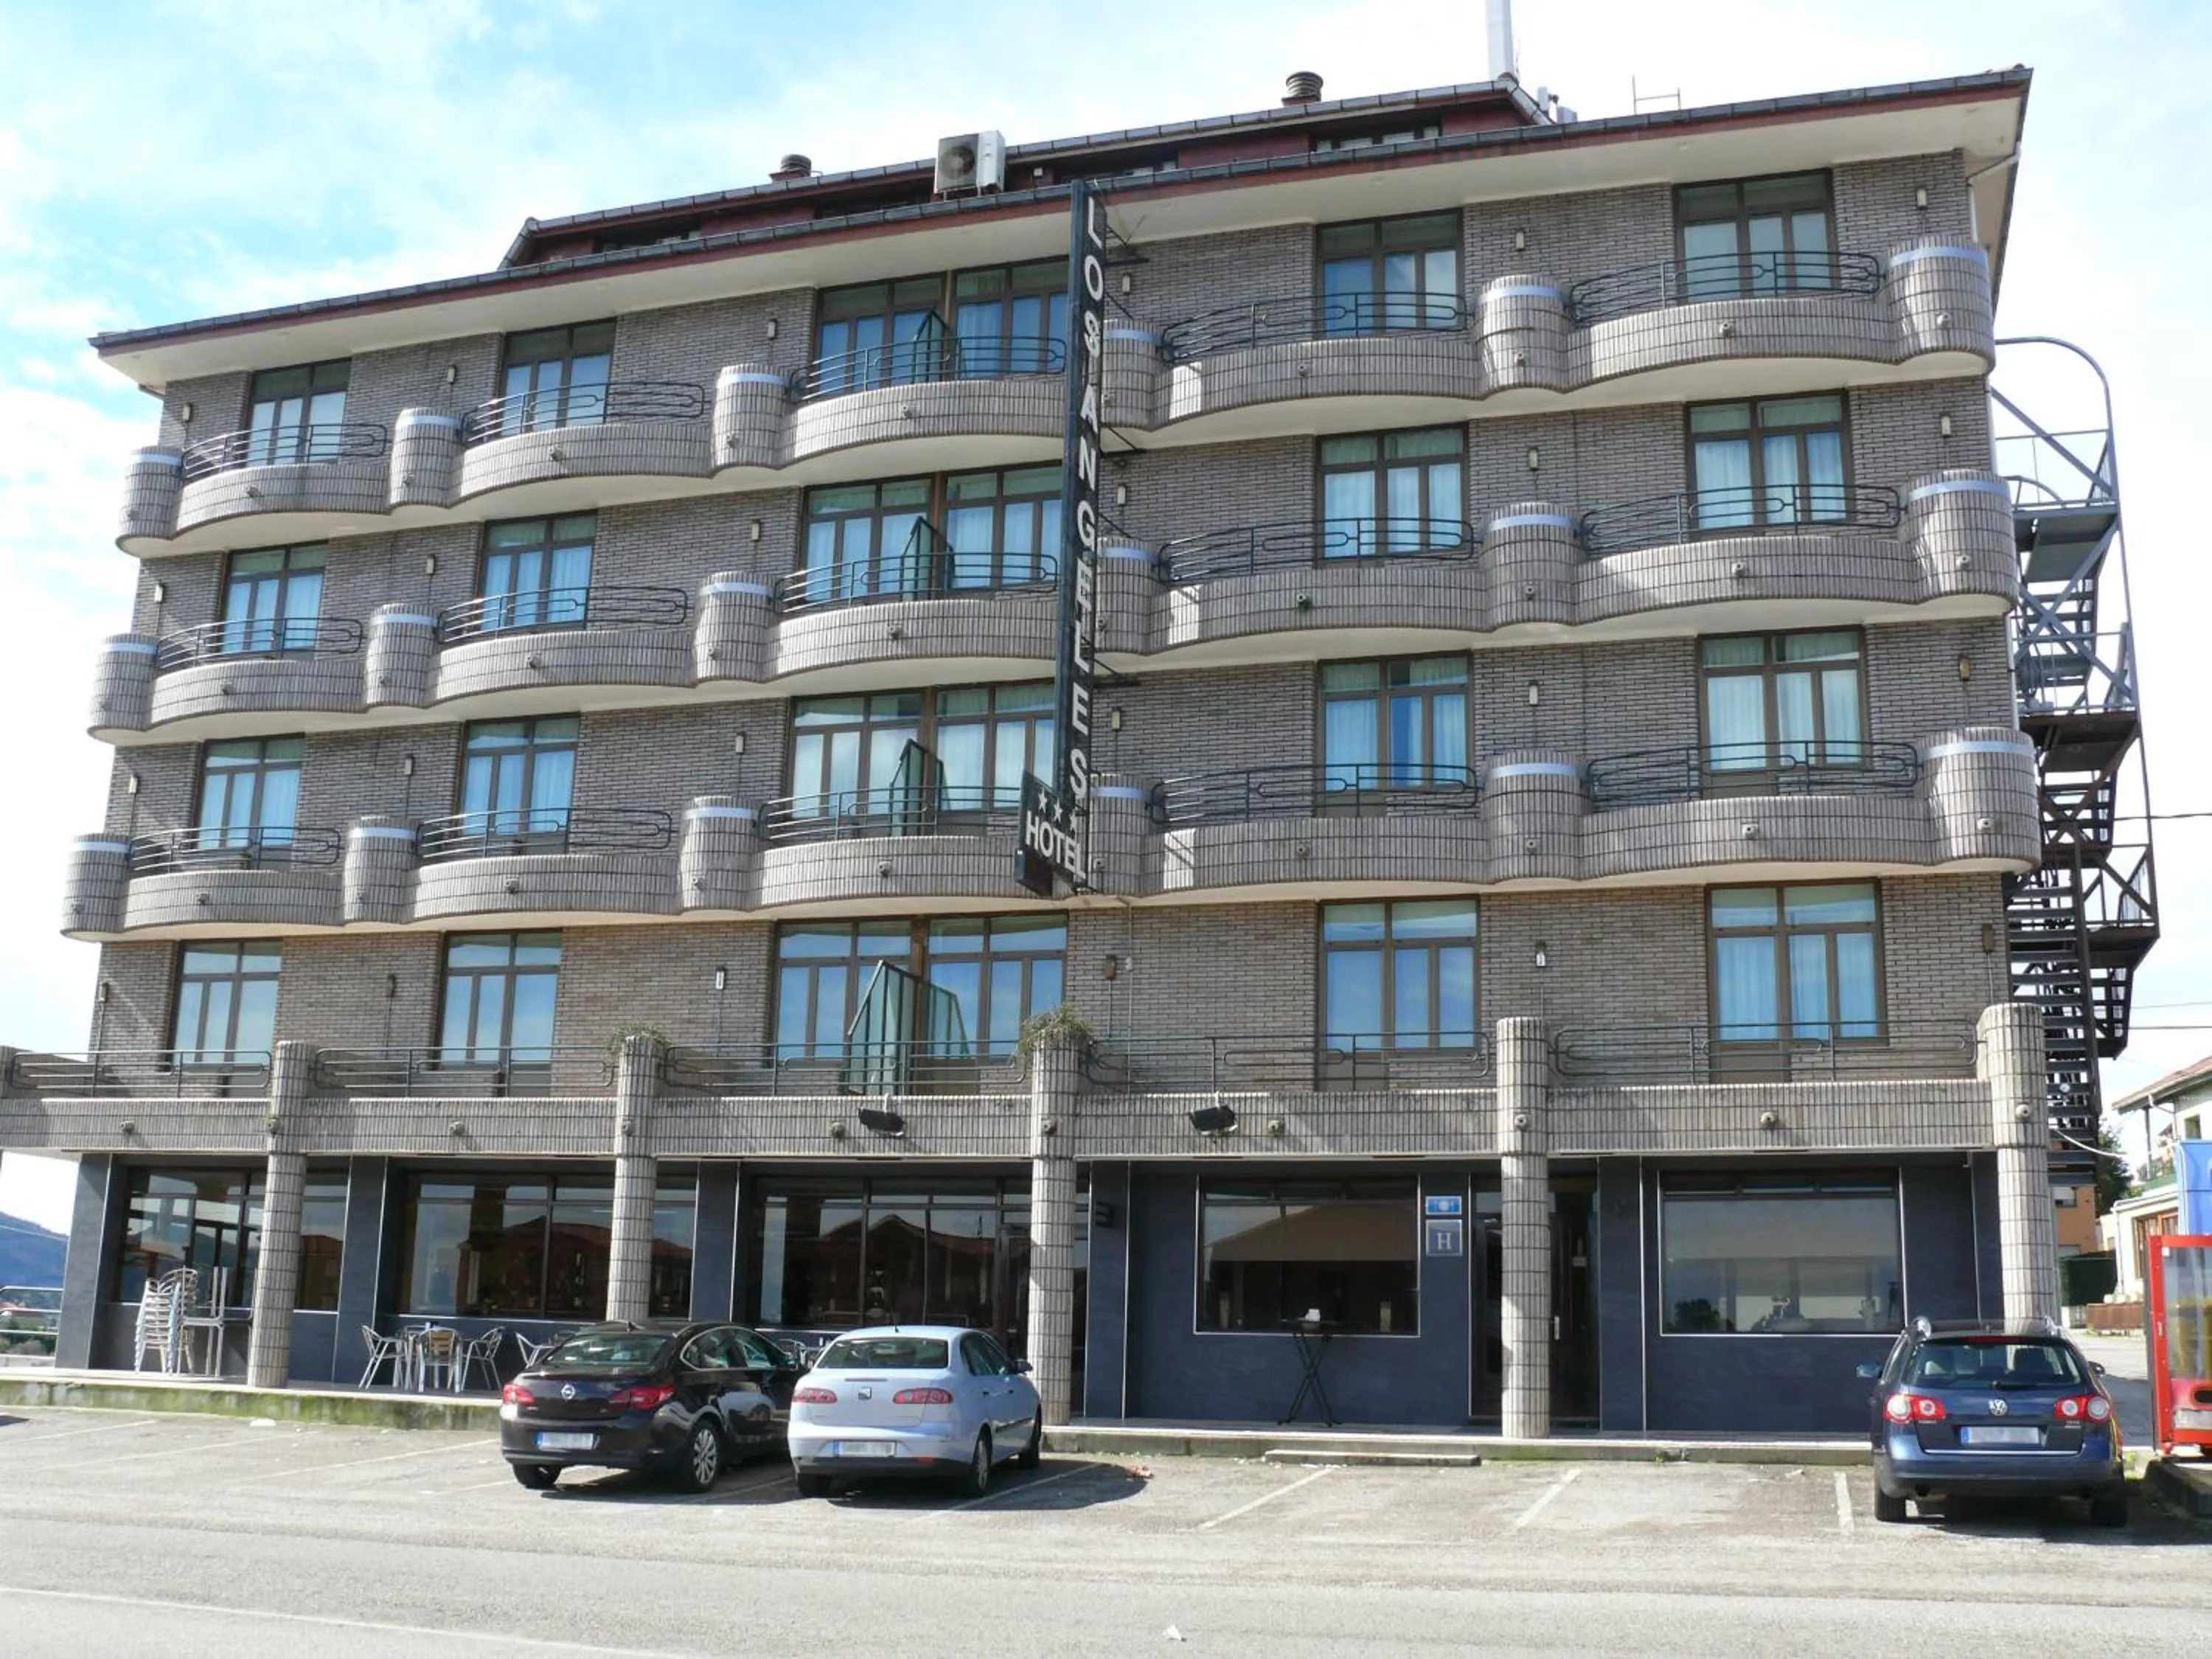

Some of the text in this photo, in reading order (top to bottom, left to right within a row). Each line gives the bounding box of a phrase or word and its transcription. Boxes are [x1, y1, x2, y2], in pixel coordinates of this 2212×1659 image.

[1070, 197, 1104, 799] LOS ANGELES
[1026, 811, 1086, 880] HOTEL
[1436, 1232, 1452, 1250] H
